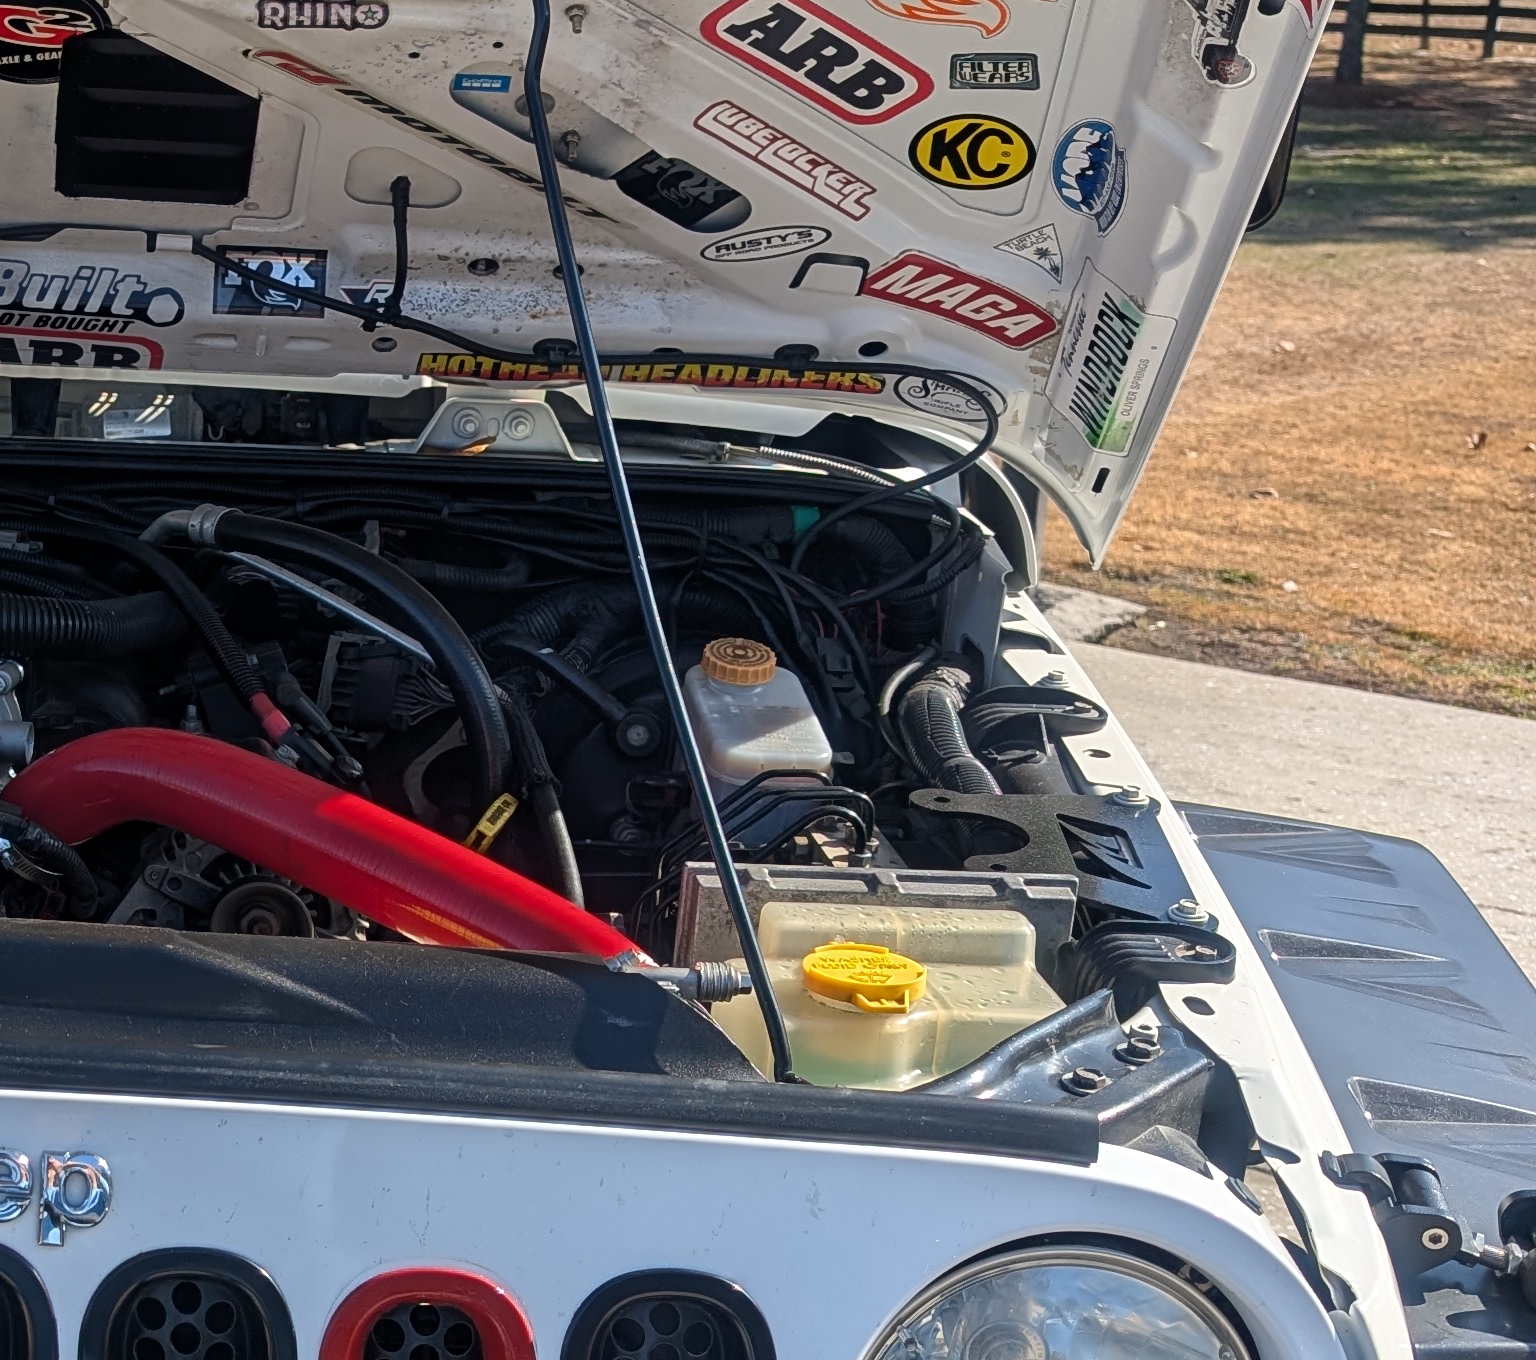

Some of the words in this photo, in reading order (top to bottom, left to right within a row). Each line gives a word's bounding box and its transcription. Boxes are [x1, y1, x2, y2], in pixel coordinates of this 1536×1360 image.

[263, 1, 385, 27] RHINO
[23, 52, 33, 63] &
[722, 2, 906, 111] ARB
[959, 60, 1030, 73] FILTER
[959, 71, 1031, 84] WEARS
[927, 122, 1015, 181] KC
[714, 228, 814, 254] RUSTY'S
[1004, 228, 1048, 249] TURTLE
[1015, 235, 1054, 252] BEACH
[869, 264, 1046, 340] MAGA
[38, 314, 135, 334] BOUGHT
[1068, 291, 1141, 439] WINDROCK
[1121, 391, 1138, 417] OLIVER
[1131, 358, 1150, 391] SPRINGS
